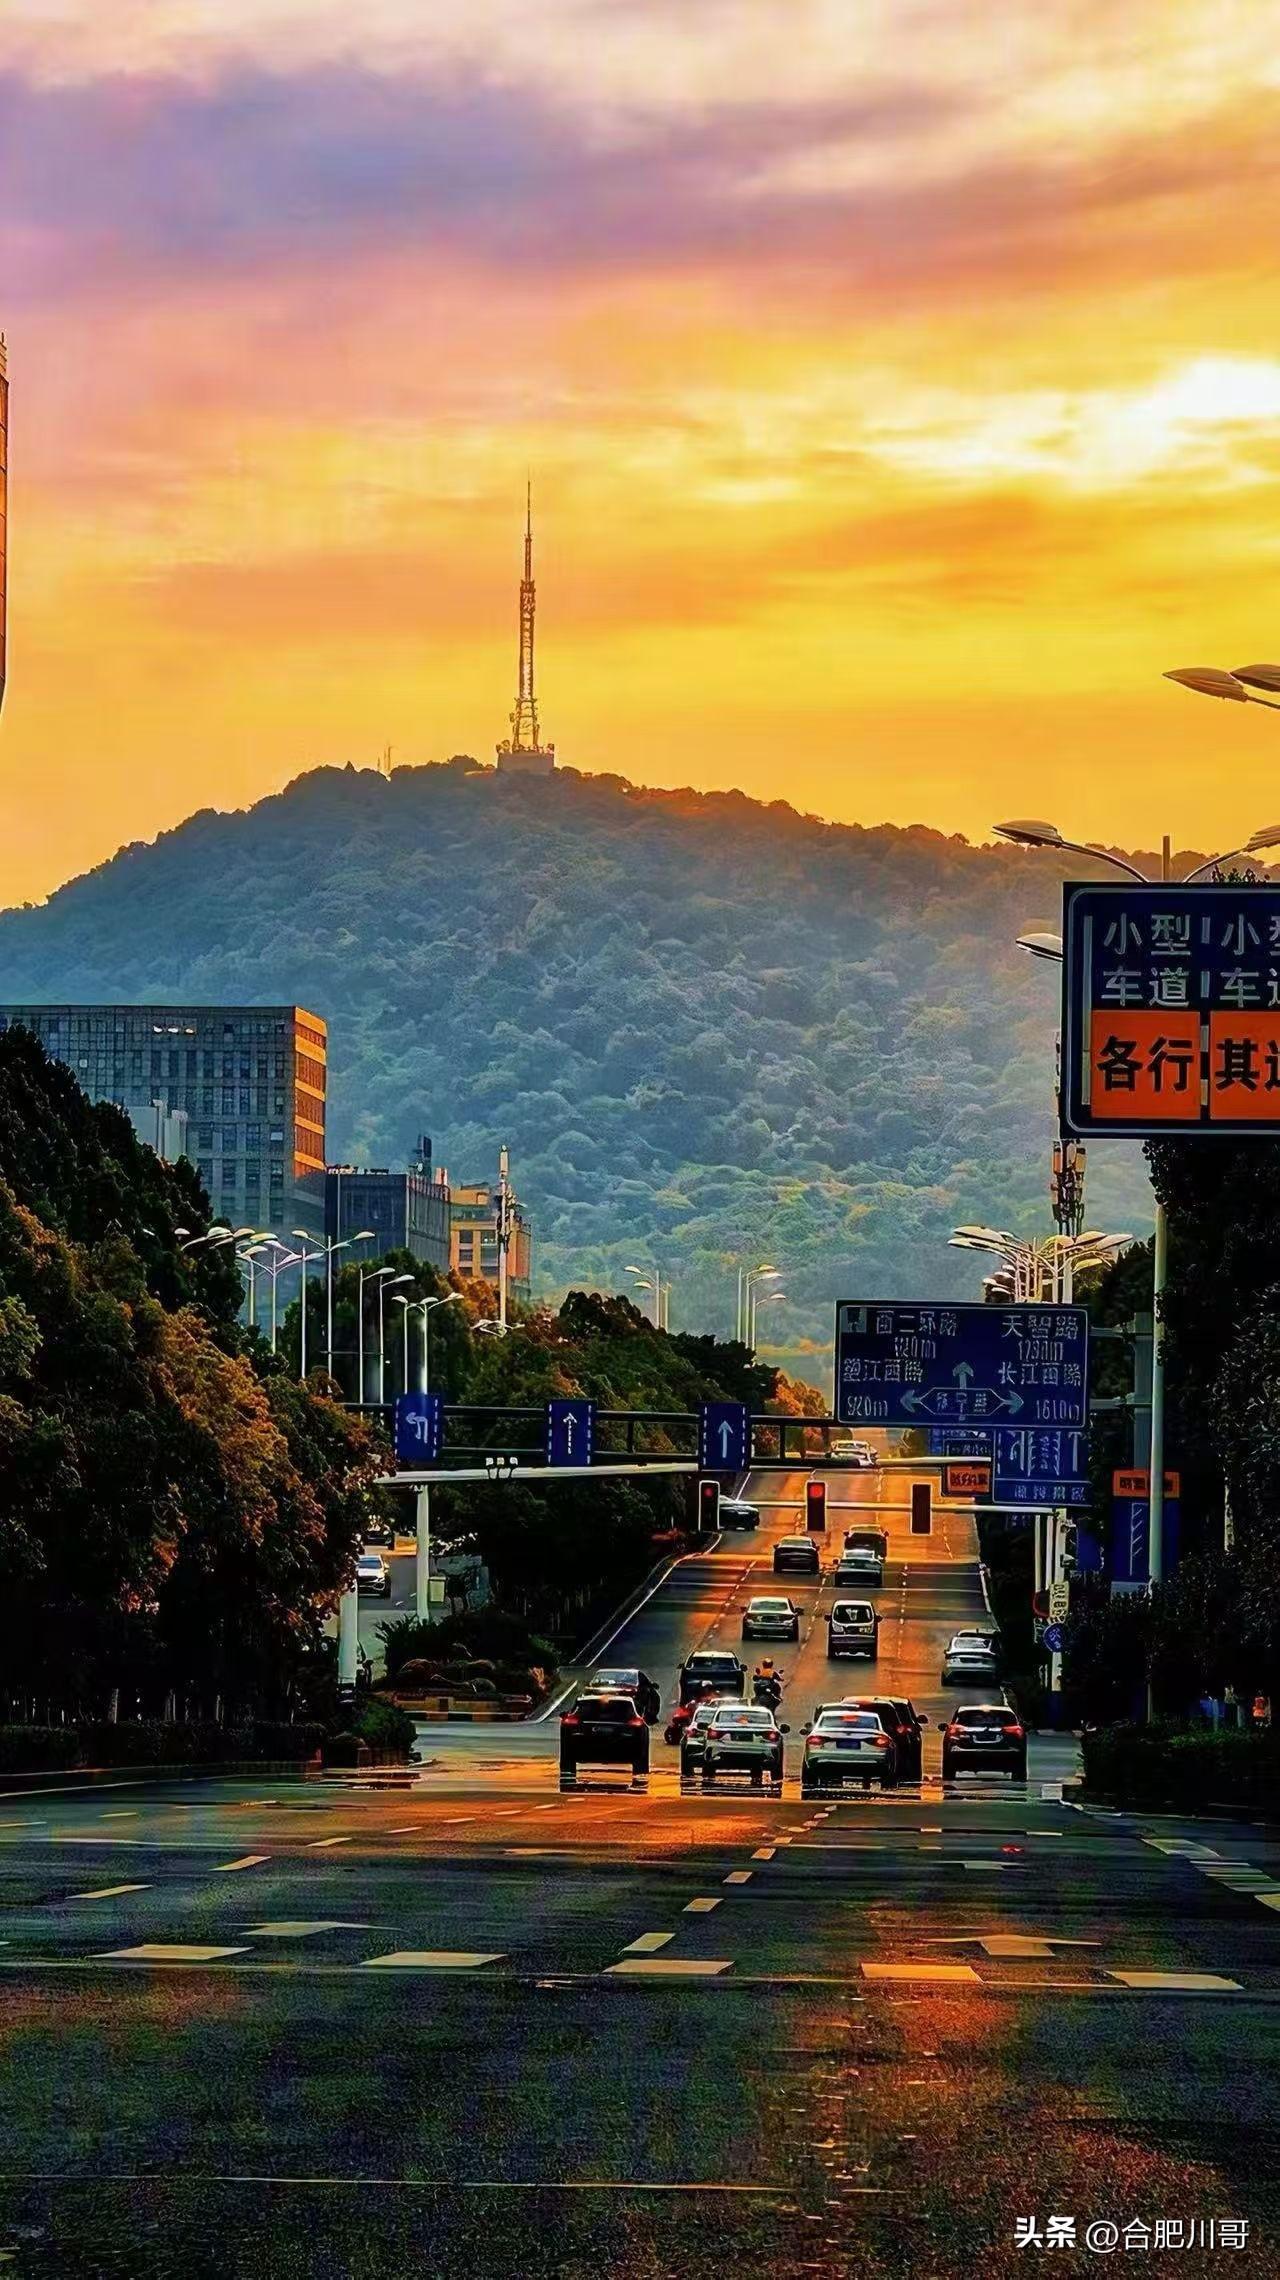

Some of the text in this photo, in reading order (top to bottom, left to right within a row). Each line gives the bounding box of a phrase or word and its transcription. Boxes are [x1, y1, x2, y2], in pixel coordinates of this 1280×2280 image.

[1104, 913, 1190, 955] 小型
[1101, 966, 1190, 1007] 车道
[1097, 1036, 1194, 1092] 各行
[1002, 1315, 1078, 1339] 天智路
[843, 1358, 923, 1383] 望江西路
[998, 1362, 1081, 1386] 长江西路
[1035, 1400, 1080, 1421] 1610m
